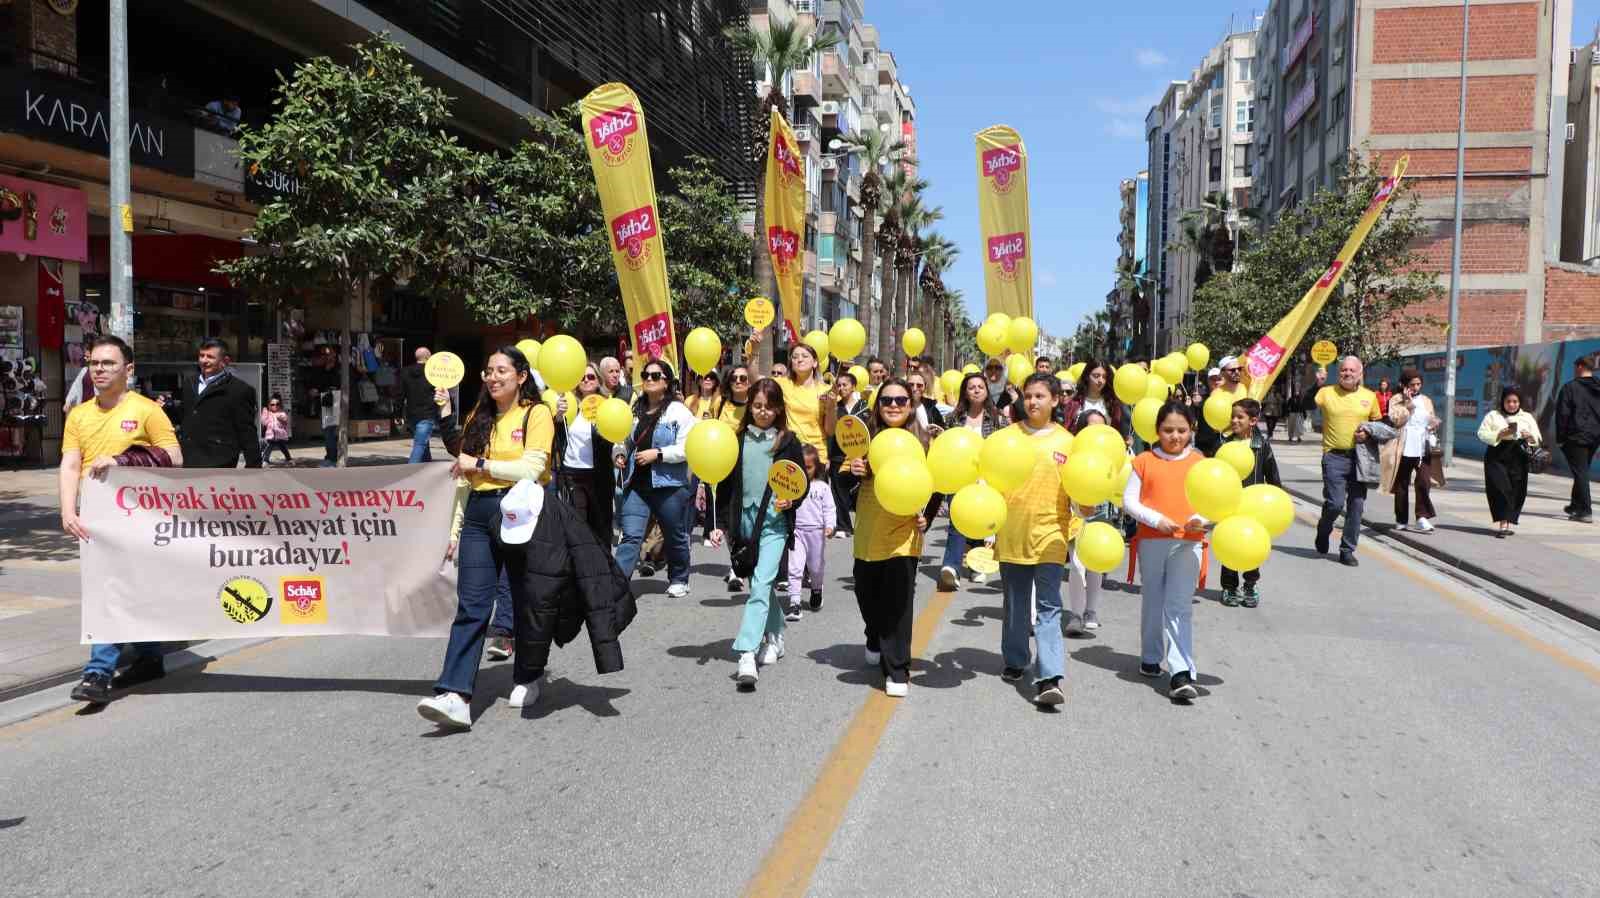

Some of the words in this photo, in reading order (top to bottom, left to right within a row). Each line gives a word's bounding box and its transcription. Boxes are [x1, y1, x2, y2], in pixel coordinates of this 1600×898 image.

[25, 88, 164, 157] KARAAN
[116, 486, 208, 516] Çölyak
[209, 486, 257, 515] için
[260, 491, 311, 516] yan
[315, 489, 425, 513] yanayız,
[153, 514, 270, 546] glutensiz
[272, 513, 347, 542] hayat
[351, 512, 398, 541] için
[209, 541, 351, 571] buradayız!
[287, 584, 318, 598] Schär
